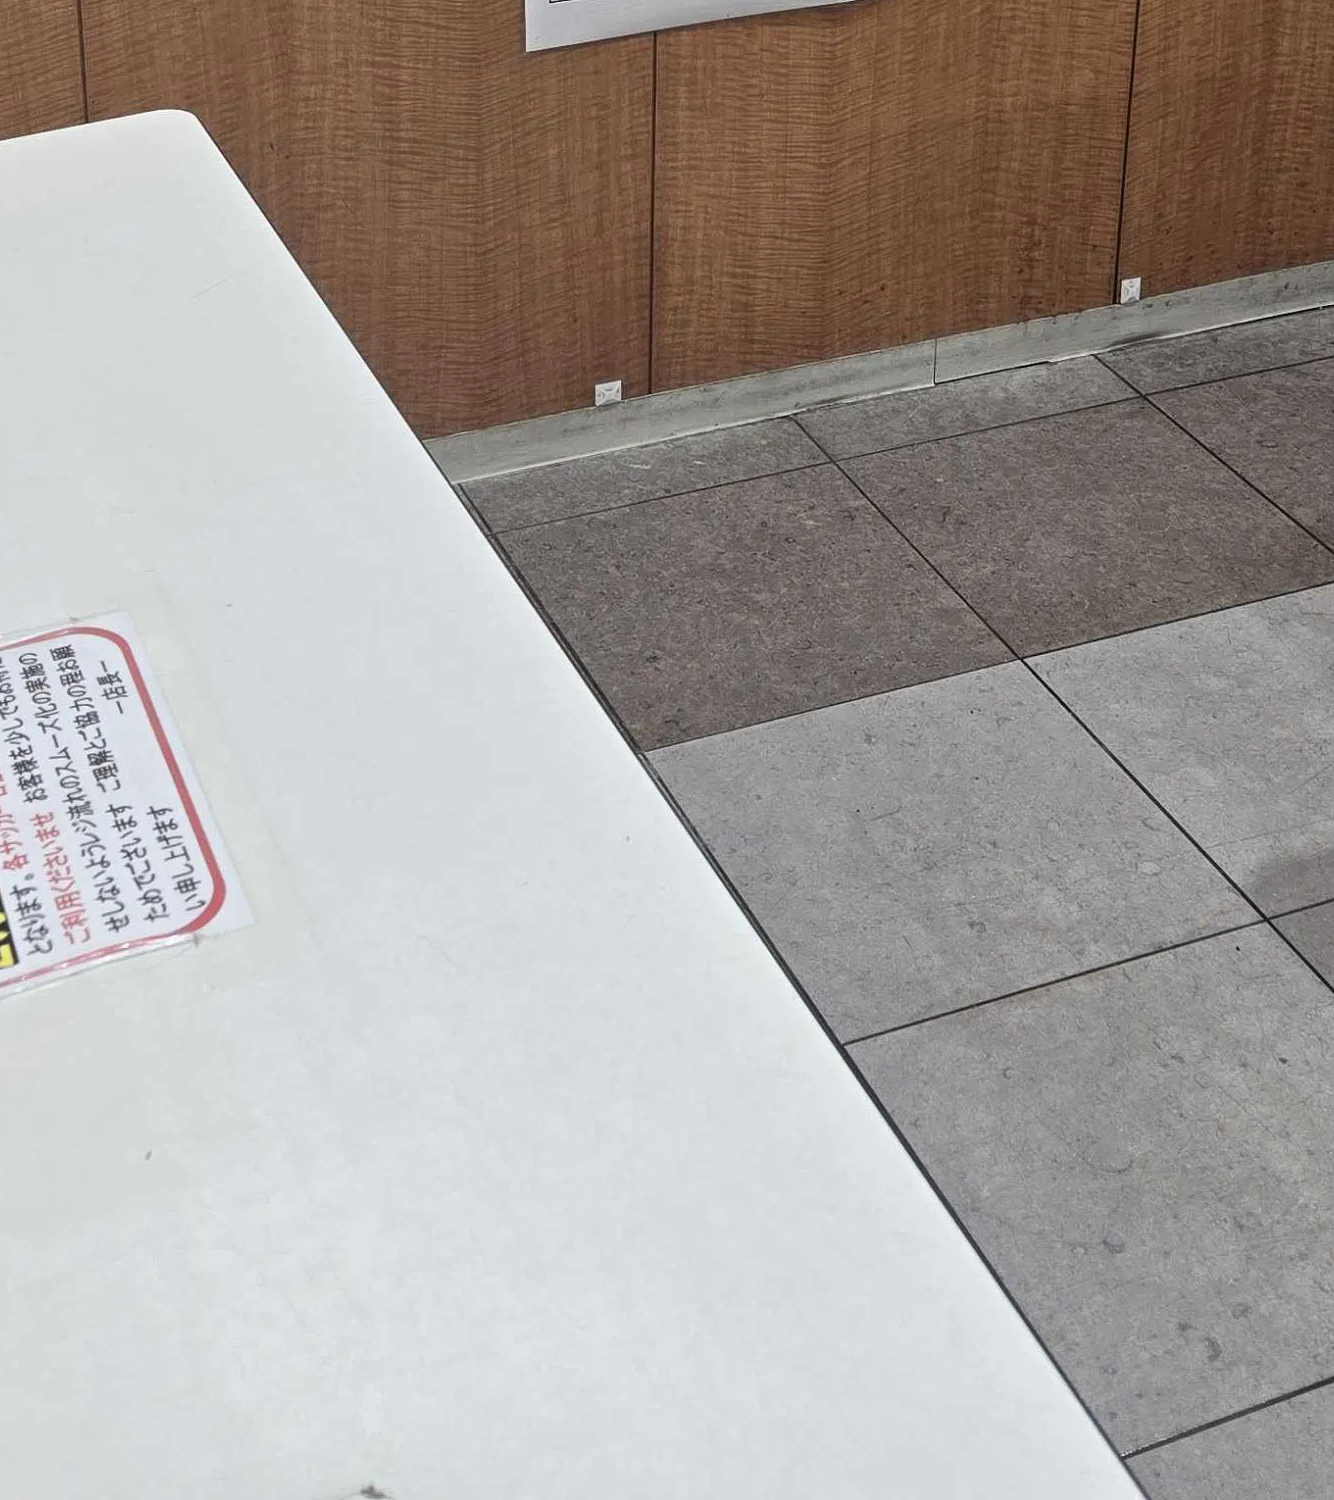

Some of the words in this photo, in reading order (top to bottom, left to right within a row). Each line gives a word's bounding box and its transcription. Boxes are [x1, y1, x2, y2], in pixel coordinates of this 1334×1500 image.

[49, 643, 126, 793] ご理解とご協力の程お願
[13, 650, 136, 933] せしないようレジ流れのスムーズ化の実施の
[145, 800, 210, 911] い申し上げます
[28, 810, 95, 945] ご利用くださいませ
[103, 798, 174, 923] ためでございます
